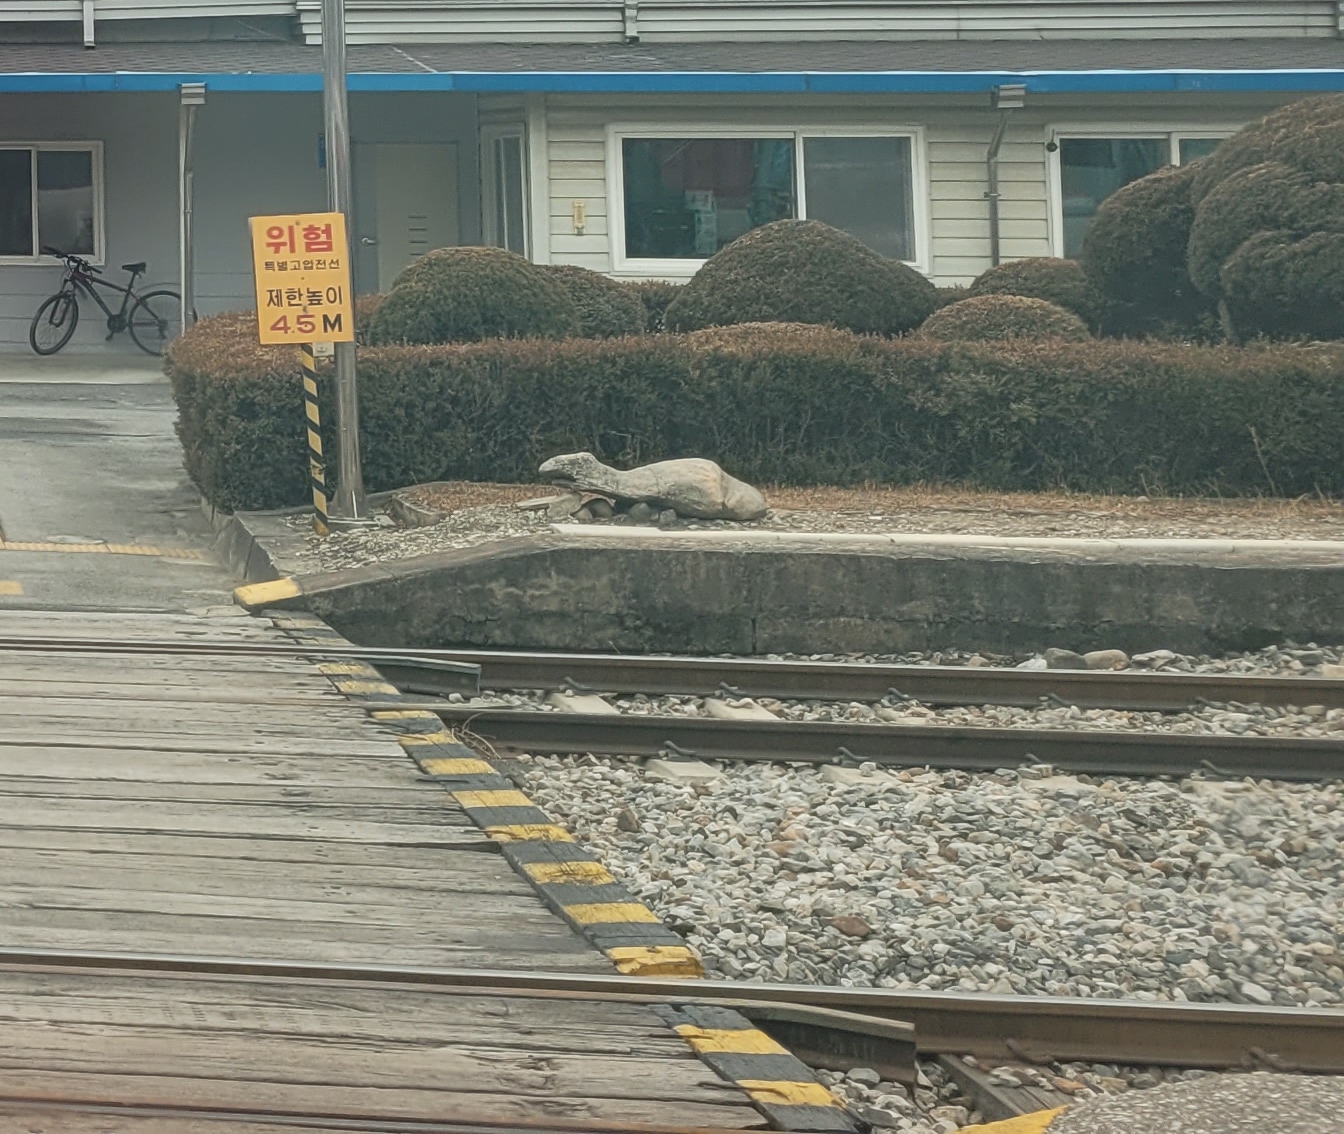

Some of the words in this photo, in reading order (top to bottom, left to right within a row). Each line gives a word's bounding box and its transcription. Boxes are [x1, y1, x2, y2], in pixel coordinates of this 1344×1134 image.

[265, 223, 334, 254] 위험
[266, 285, 343, 308] 제한높이
[322, 313, 343, 334] M
